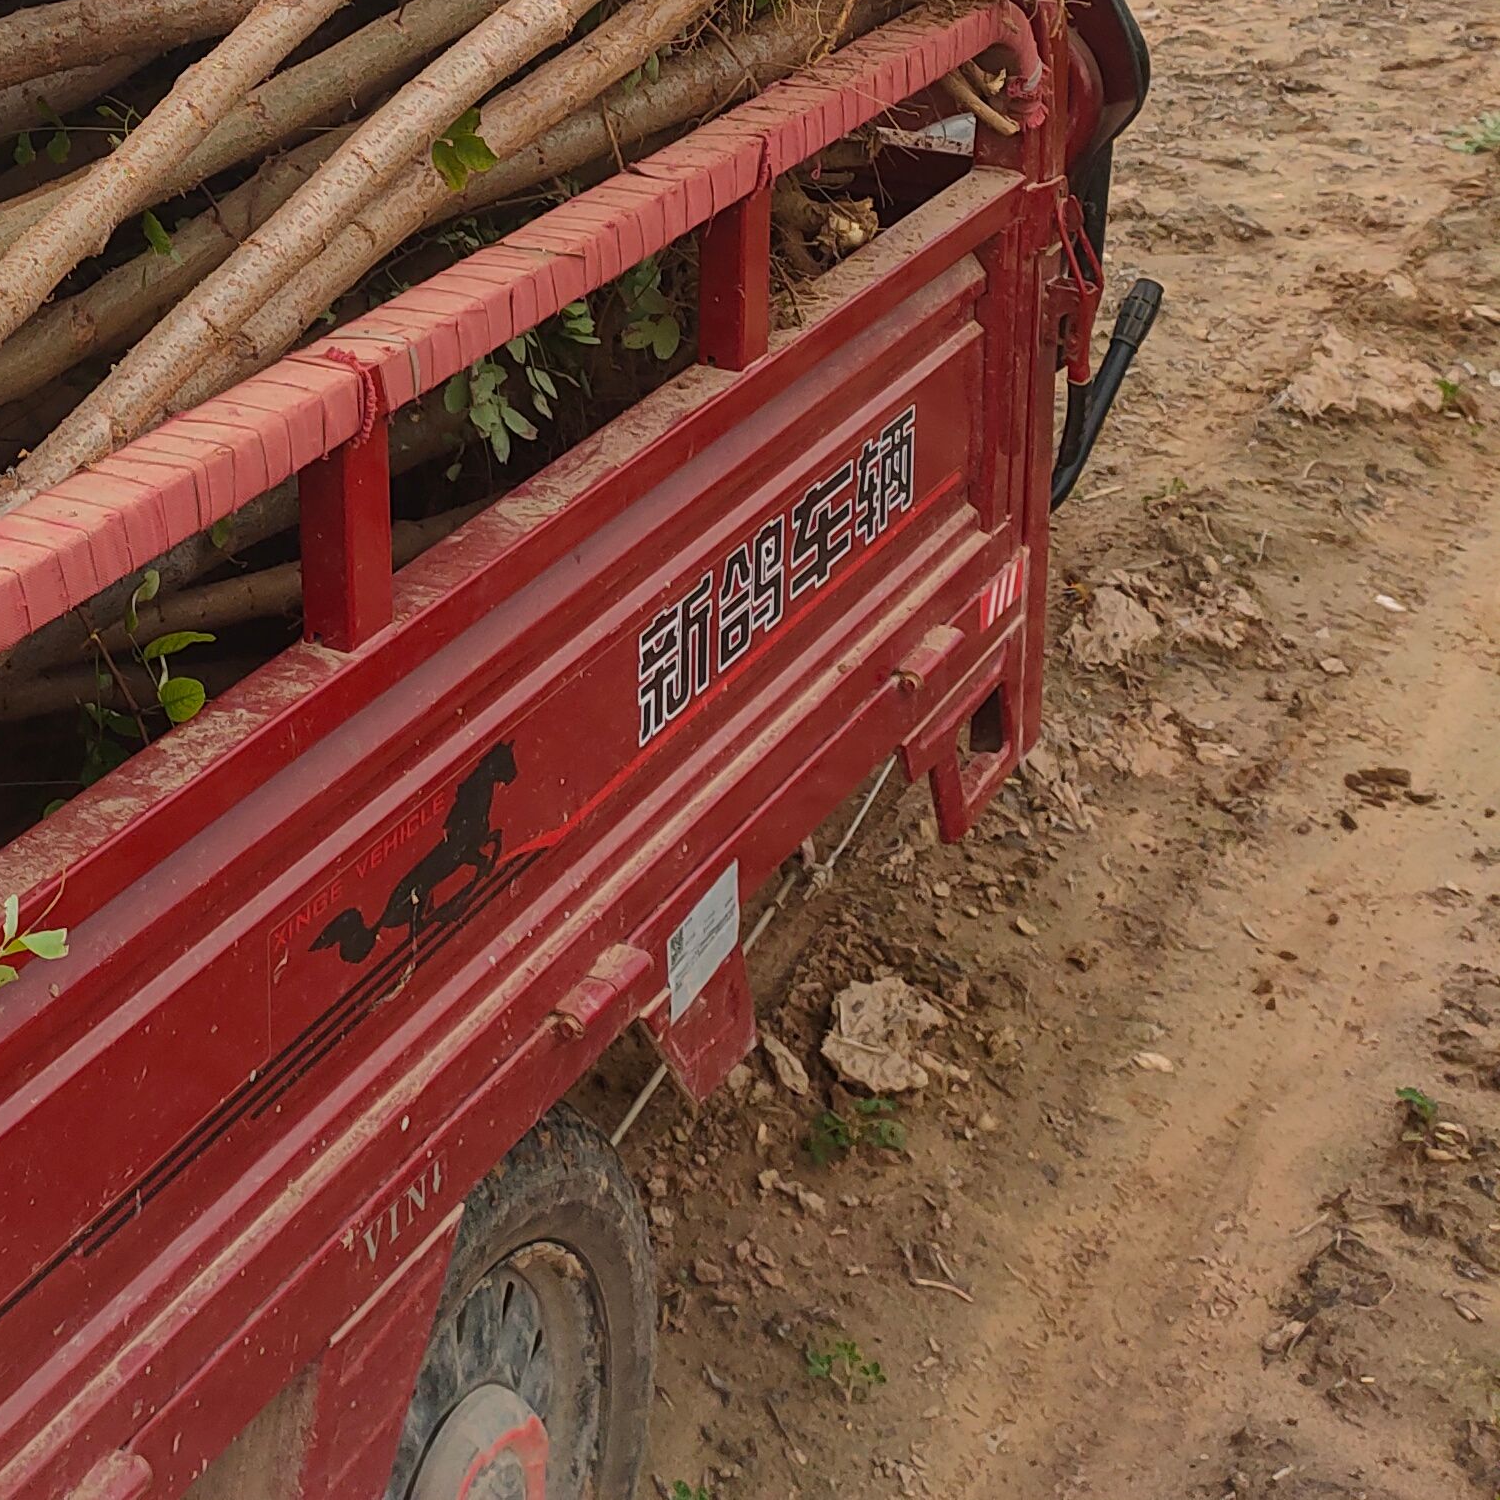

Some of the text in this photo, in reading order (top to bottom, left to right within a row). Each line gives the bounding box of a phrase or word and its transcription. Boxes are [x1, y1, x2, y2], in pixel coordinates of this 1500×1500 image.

[638, 404, 916, 748] 新鸽车辆
[274, 791, 446, 951] XINGE VEHICLE
